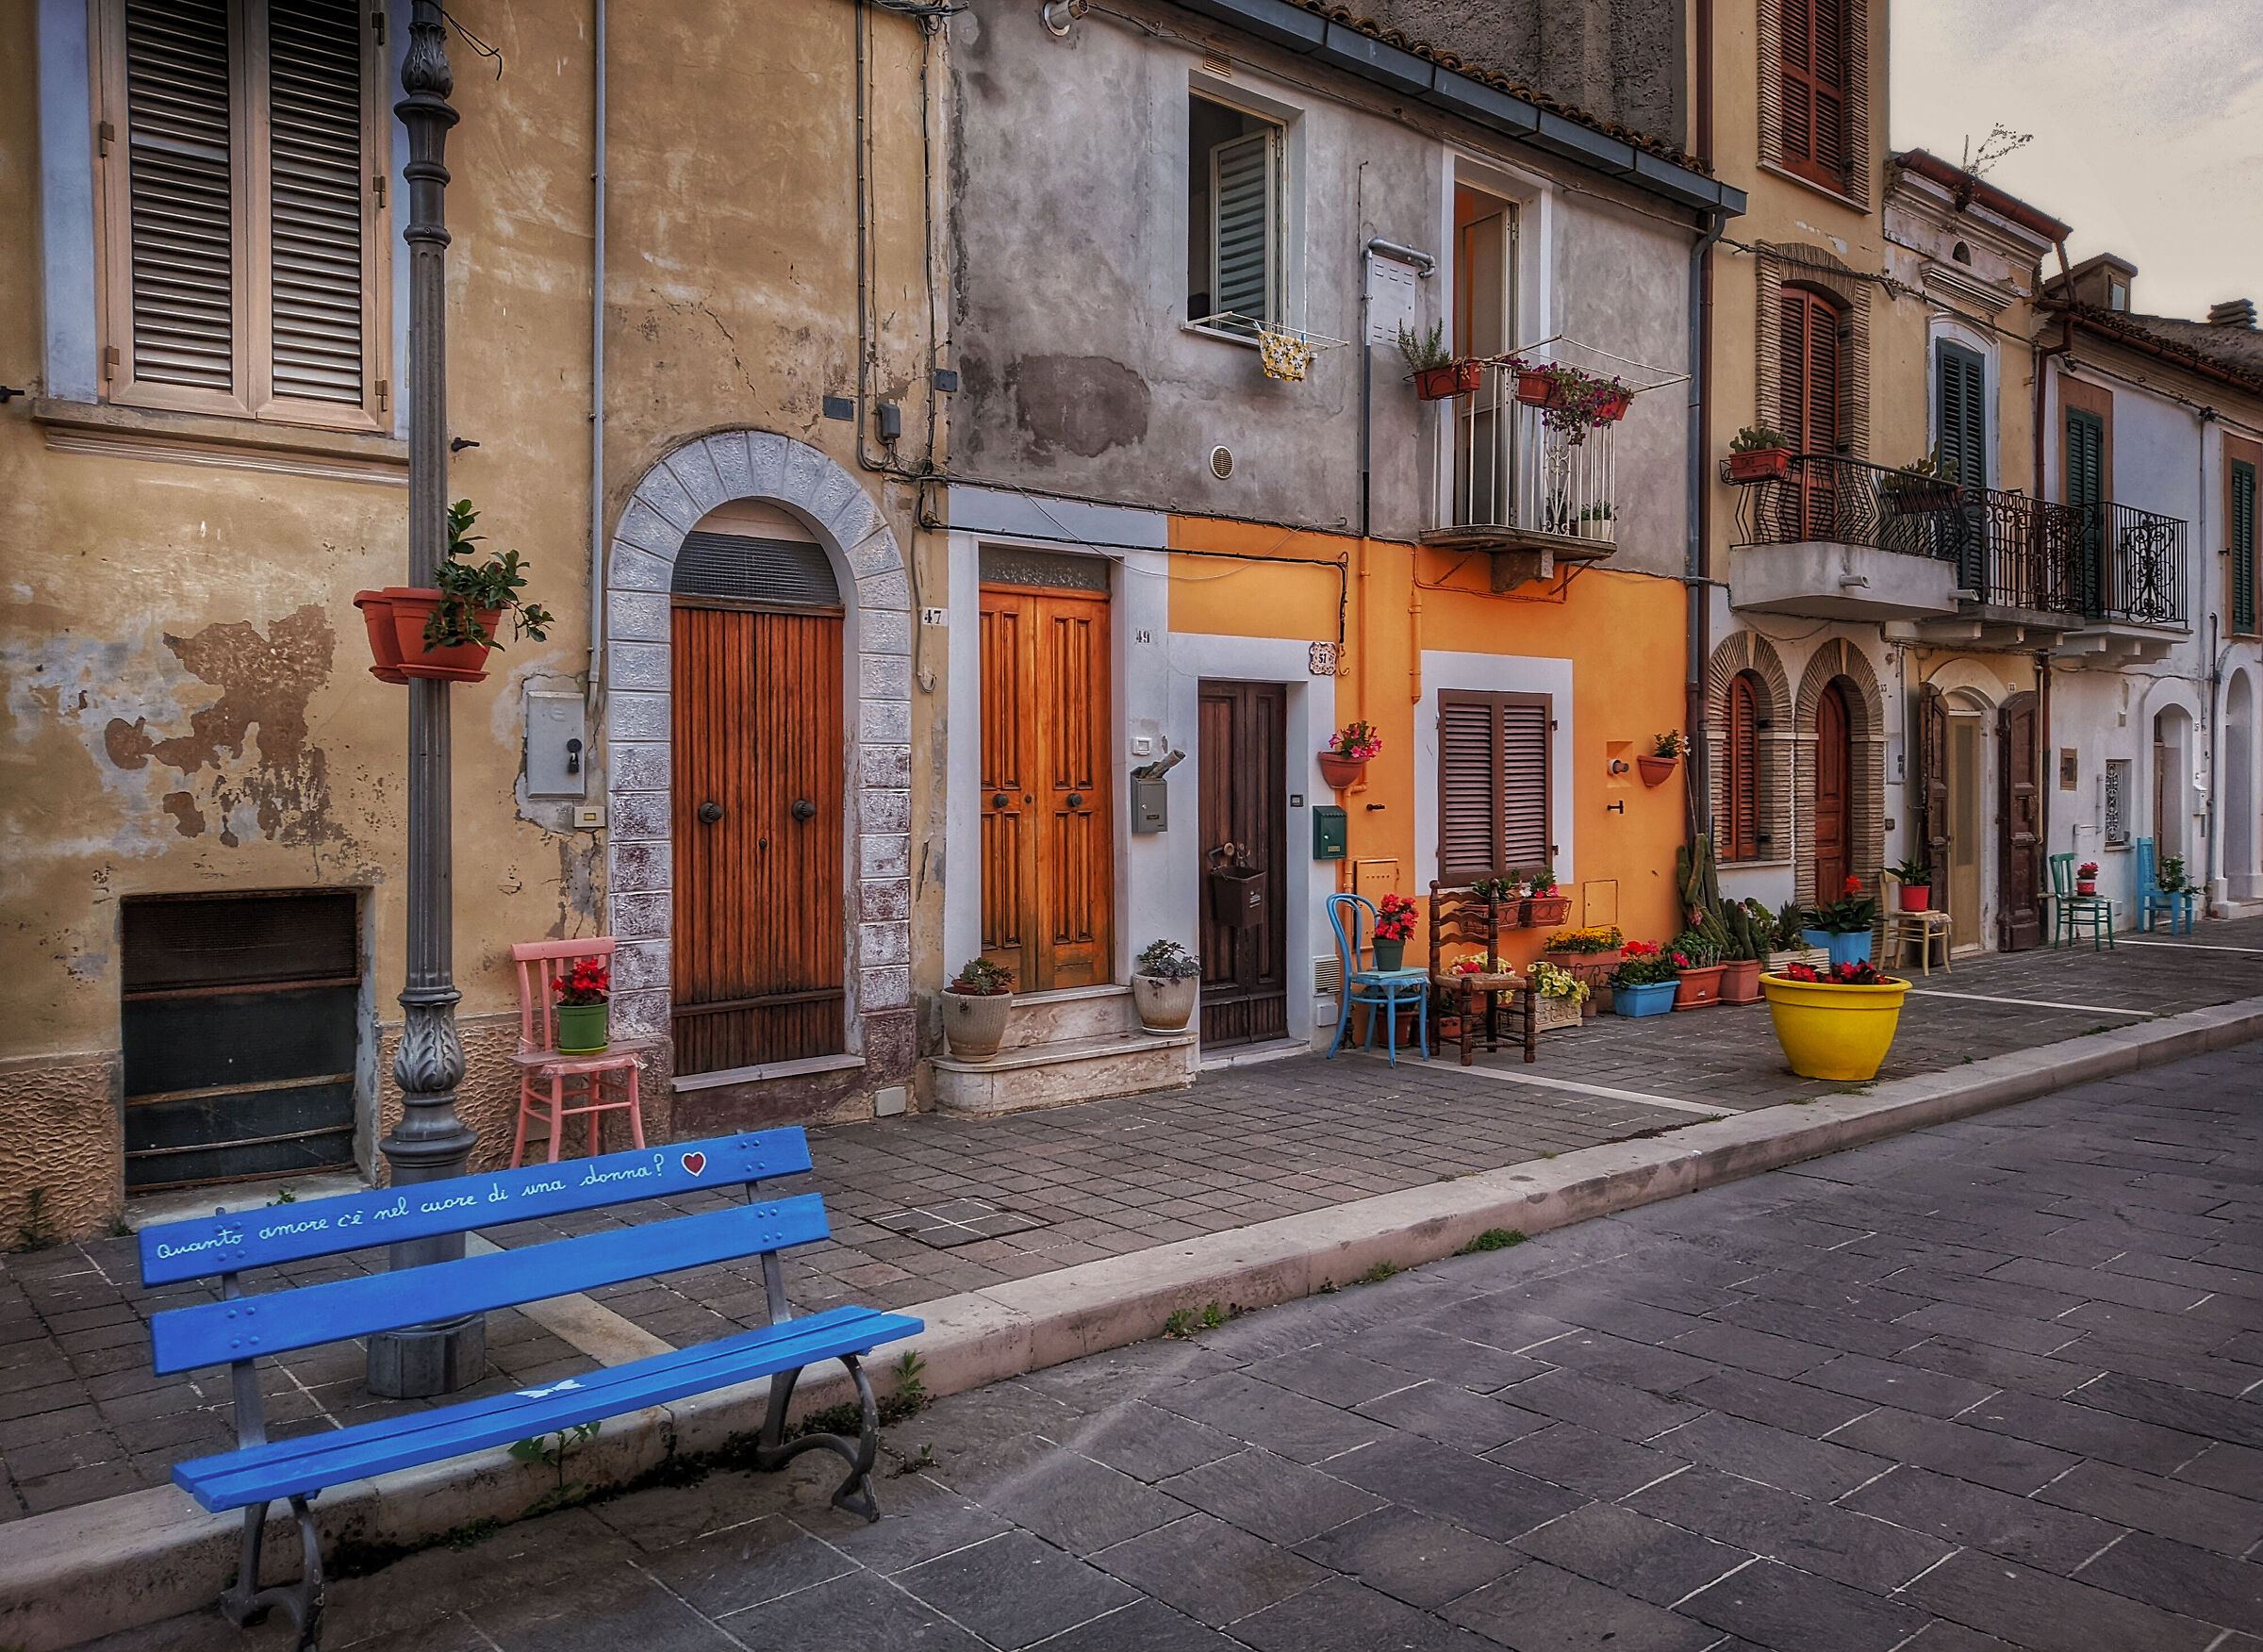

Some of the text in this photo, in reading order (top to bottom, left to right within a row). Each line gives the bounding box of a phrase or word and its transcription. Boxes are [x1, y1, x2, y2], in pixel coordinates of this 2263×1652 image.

[924, 609, 942, 624] 47
[1318, 653, 1327, 664] 51
[157, 1229, 244, 1259] Quanto
[258, 1218, 330, 1240] amore
[373, 1196, 410, 1220] nel
[421, 1195, 479, 1213] cuore
[488, 1182, 509, 1203] di
[520, 1180, 567, 1197] una
[579, 1153, 665, 1186] donna?
